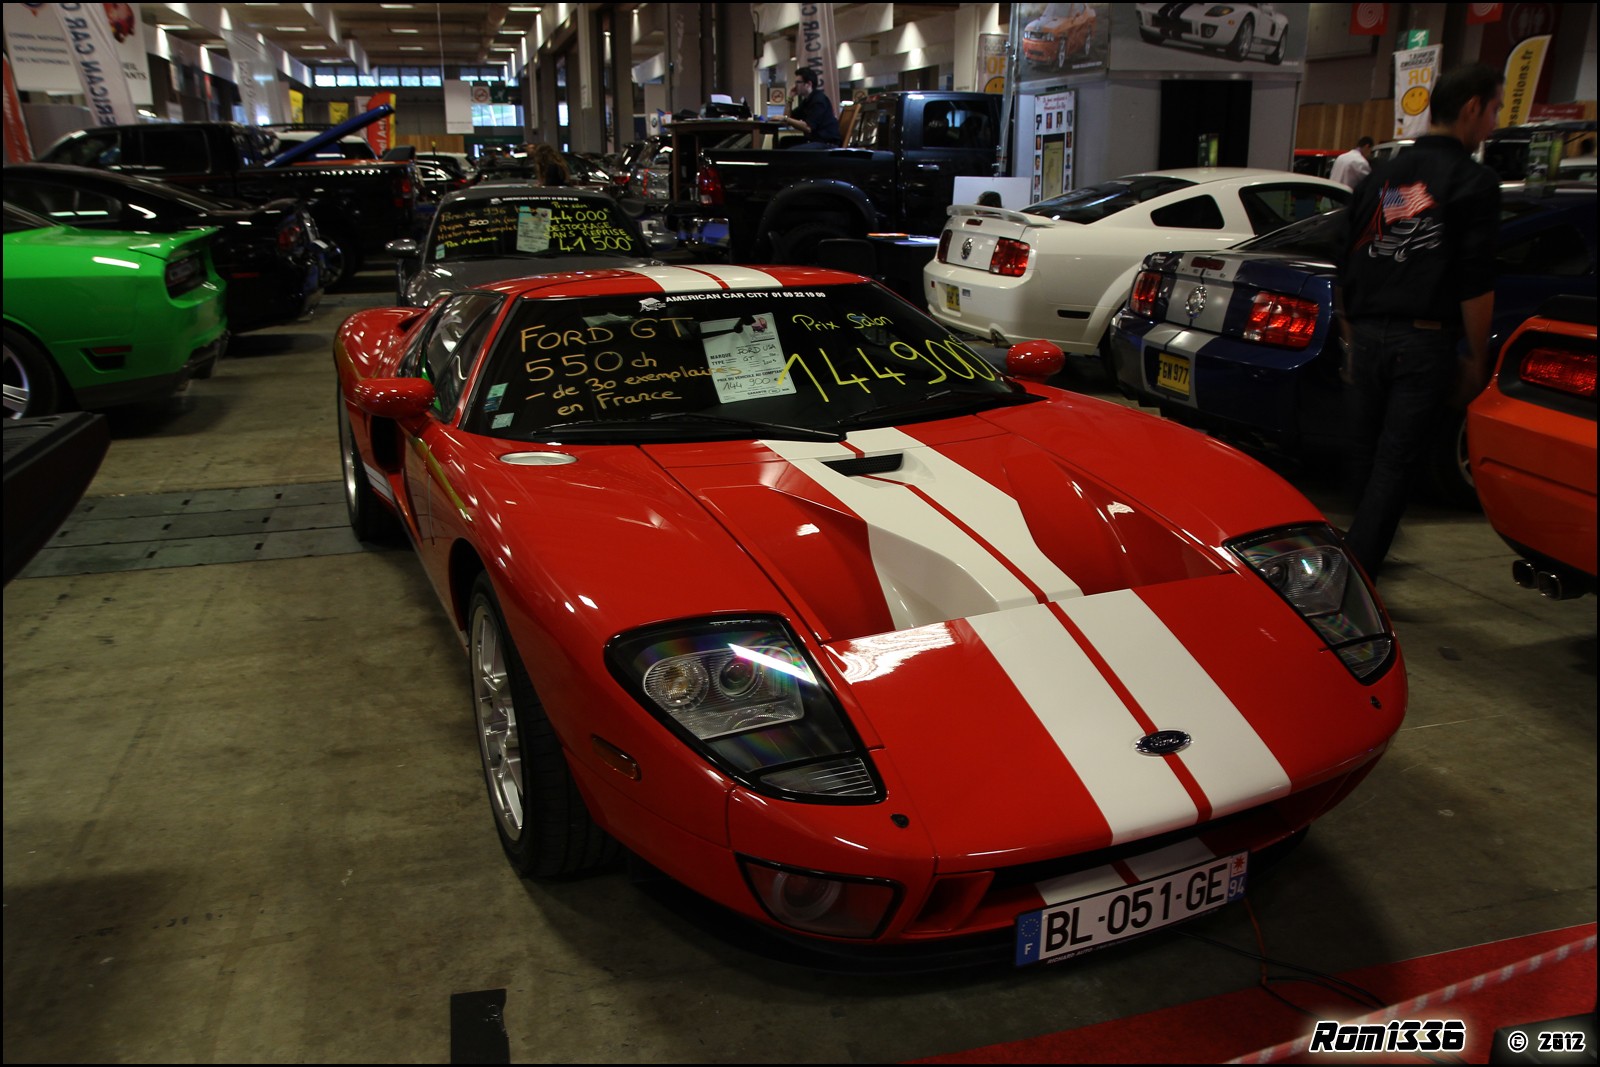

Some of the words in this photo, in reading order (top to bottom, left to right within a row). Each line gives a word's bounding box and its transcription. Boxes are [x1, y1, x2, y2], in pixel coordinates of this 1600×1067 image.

[467, 218, 490, 227] 500
[545, 221, 612, 232] DESTOCKAGE
[581, 228, 627, 237] REPRISE
[665, 292, 721, 303] AMERICAN
[722, 291, 746, 299] CAR
[746, 291, 771, 299] CITY
[791, 313, 841, 332] Prix
[846, 312, 895, 329] Salon
[520, 324, 614, 352] FORD
[630, 316, 695, 338] GT
[524, 351, 624, 382] 550
[630, 351, 658, 368] ch
[552, 384, 580, 400] de
[585, 377, 617, 392] 30
[748, 377, 771, 387] 900
[557, 402, 584, 416] en
[597, 389, 683, 410] France
[1024, 942, 1034, 956] F
[1229, 879, 1246, 898] 94
